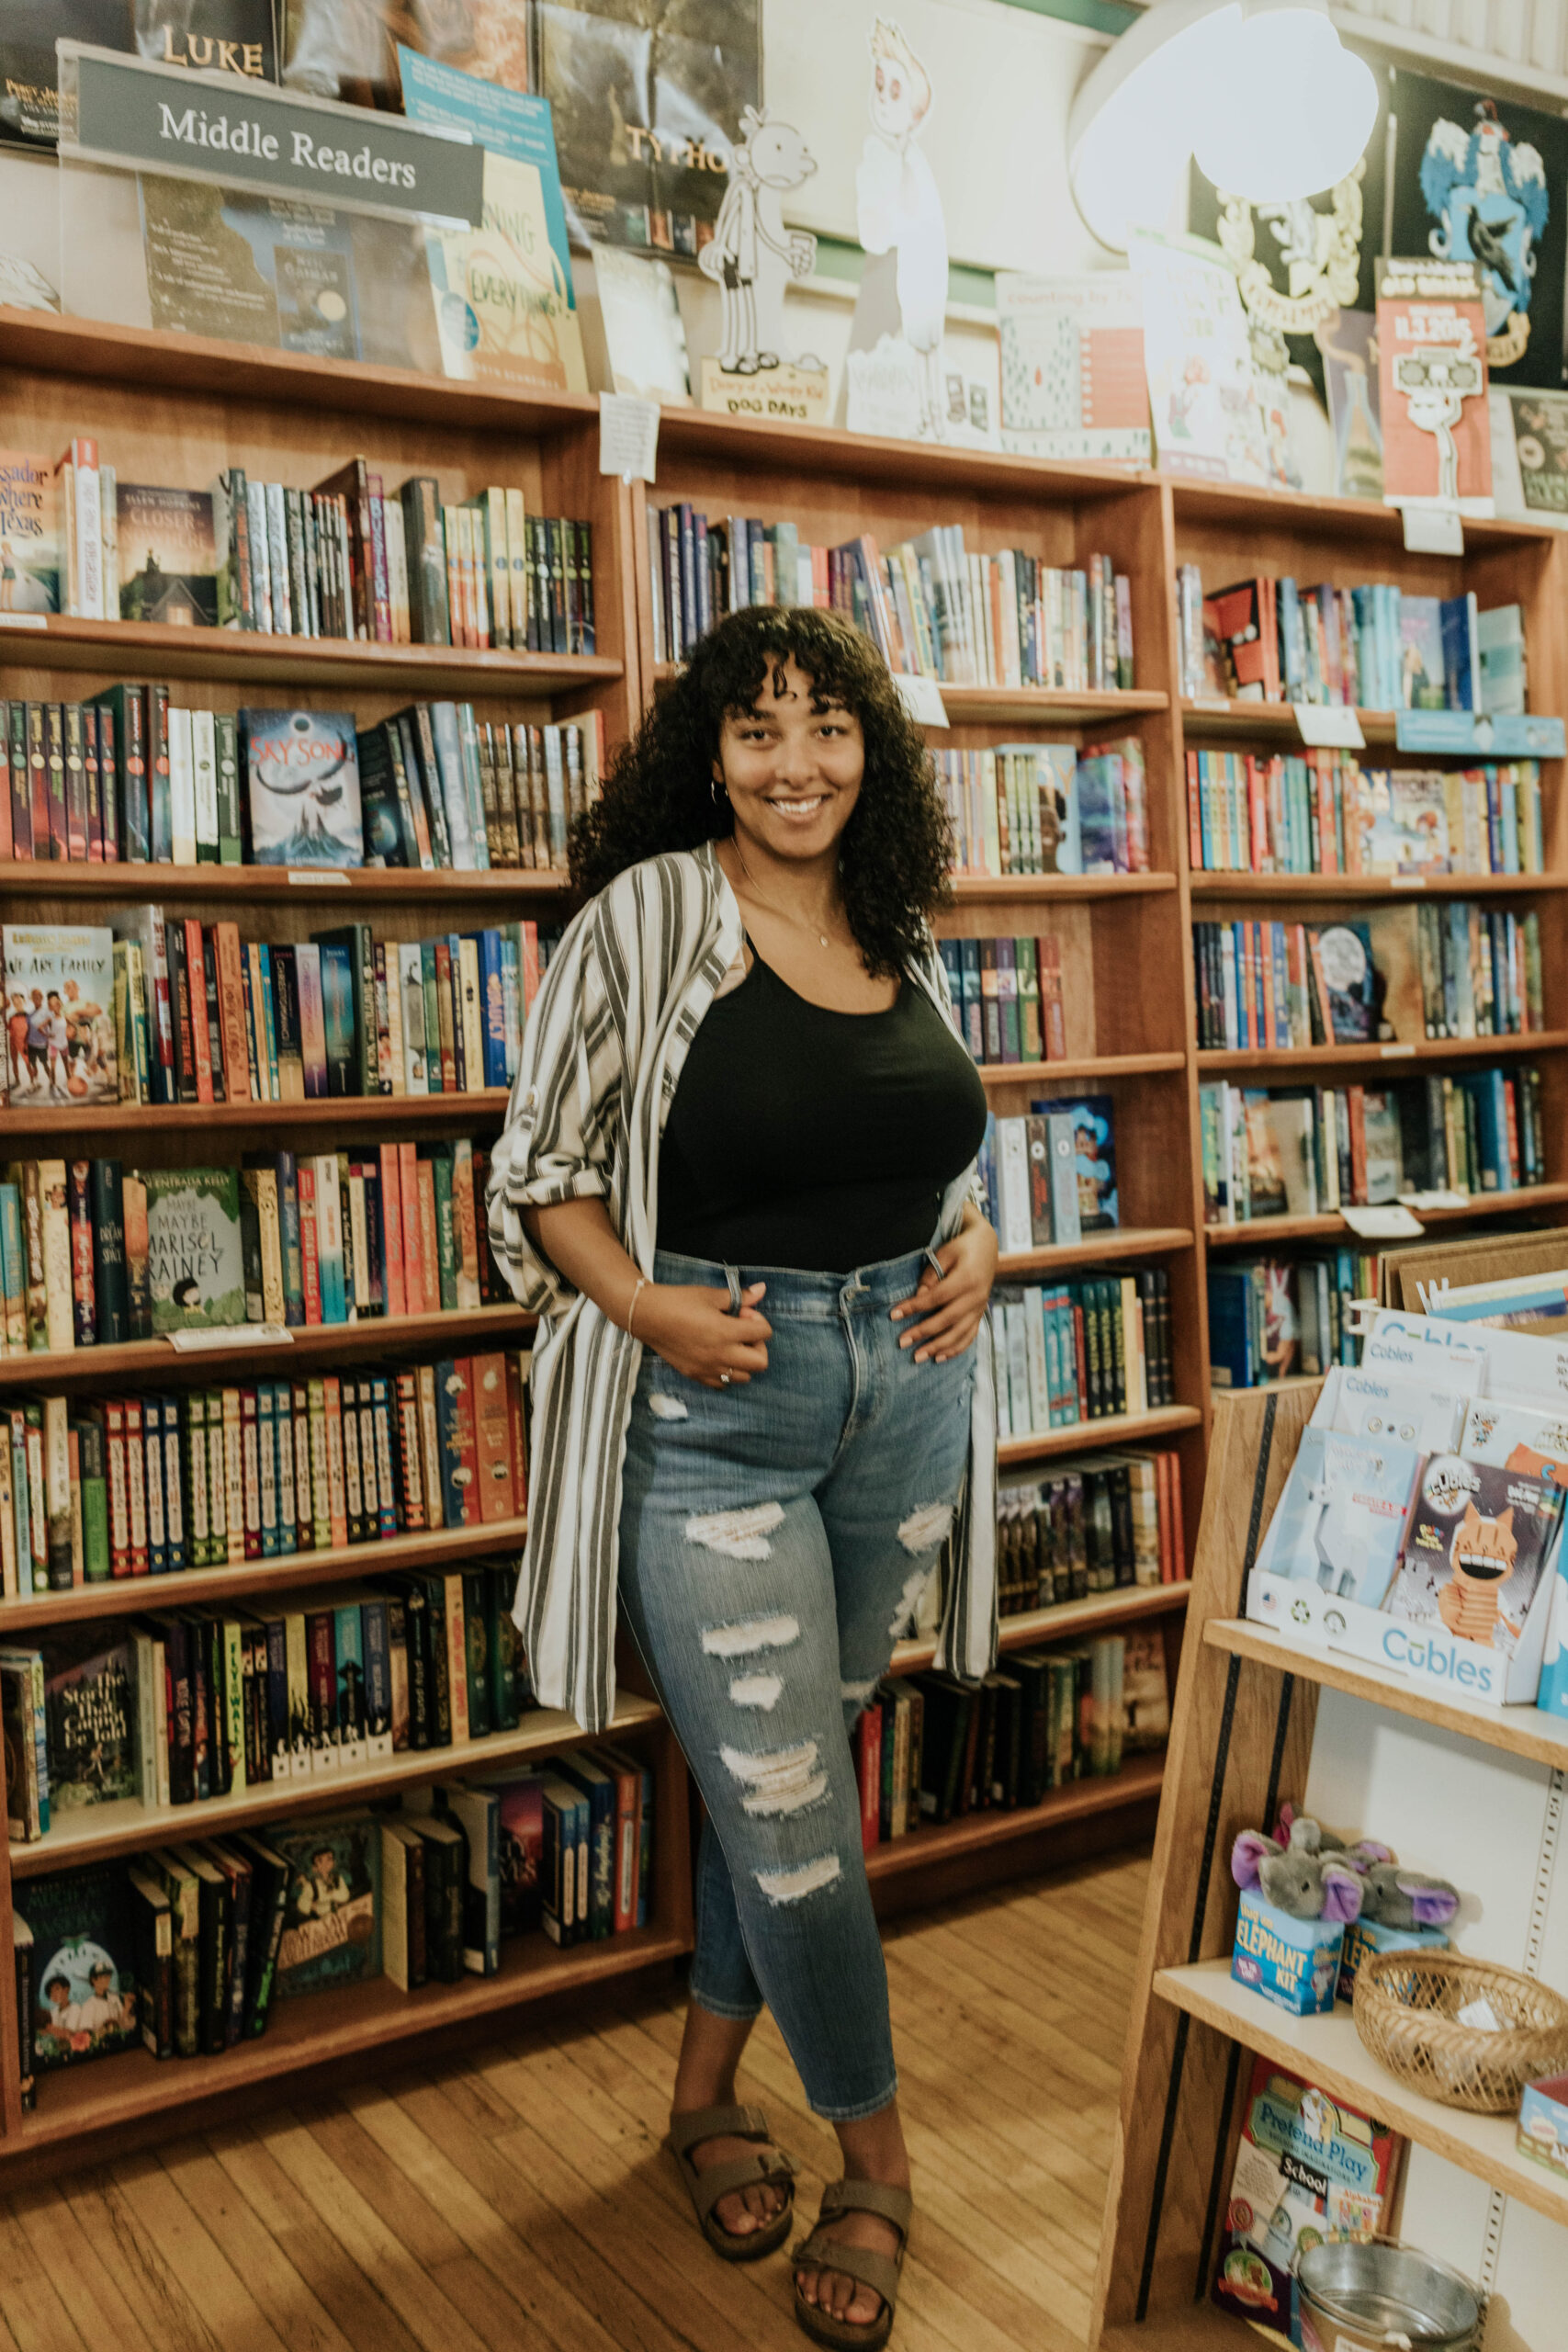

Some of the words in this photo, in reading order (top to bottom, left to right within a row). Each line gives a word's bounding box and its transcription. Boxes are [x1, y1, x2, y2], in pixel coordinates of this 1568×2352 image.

[163, 24, 265, 77] LUKE
[157, 102, 279, 162] Middle
[289, 130, 417, 189] Readers
[727, 399, 763, 413] DOG
[768, 400, 807, 418] DAYS
[130, 506, 196, 530] CLOSER
[249, 735, 294, 765] SKY
[298, 738, 355, 767] SONG
[158, 1213, 207, 1231] MAYBE
[1236, 1919, 1308, 1978] ELEPHANT
[1276, 1966, 1298, 1994] KIT
[1260, 2101, 1325, 2154] Pretend
[1329, 2139, 1367, 2184] Play
[1283, 2157, 1327, 2197] School
